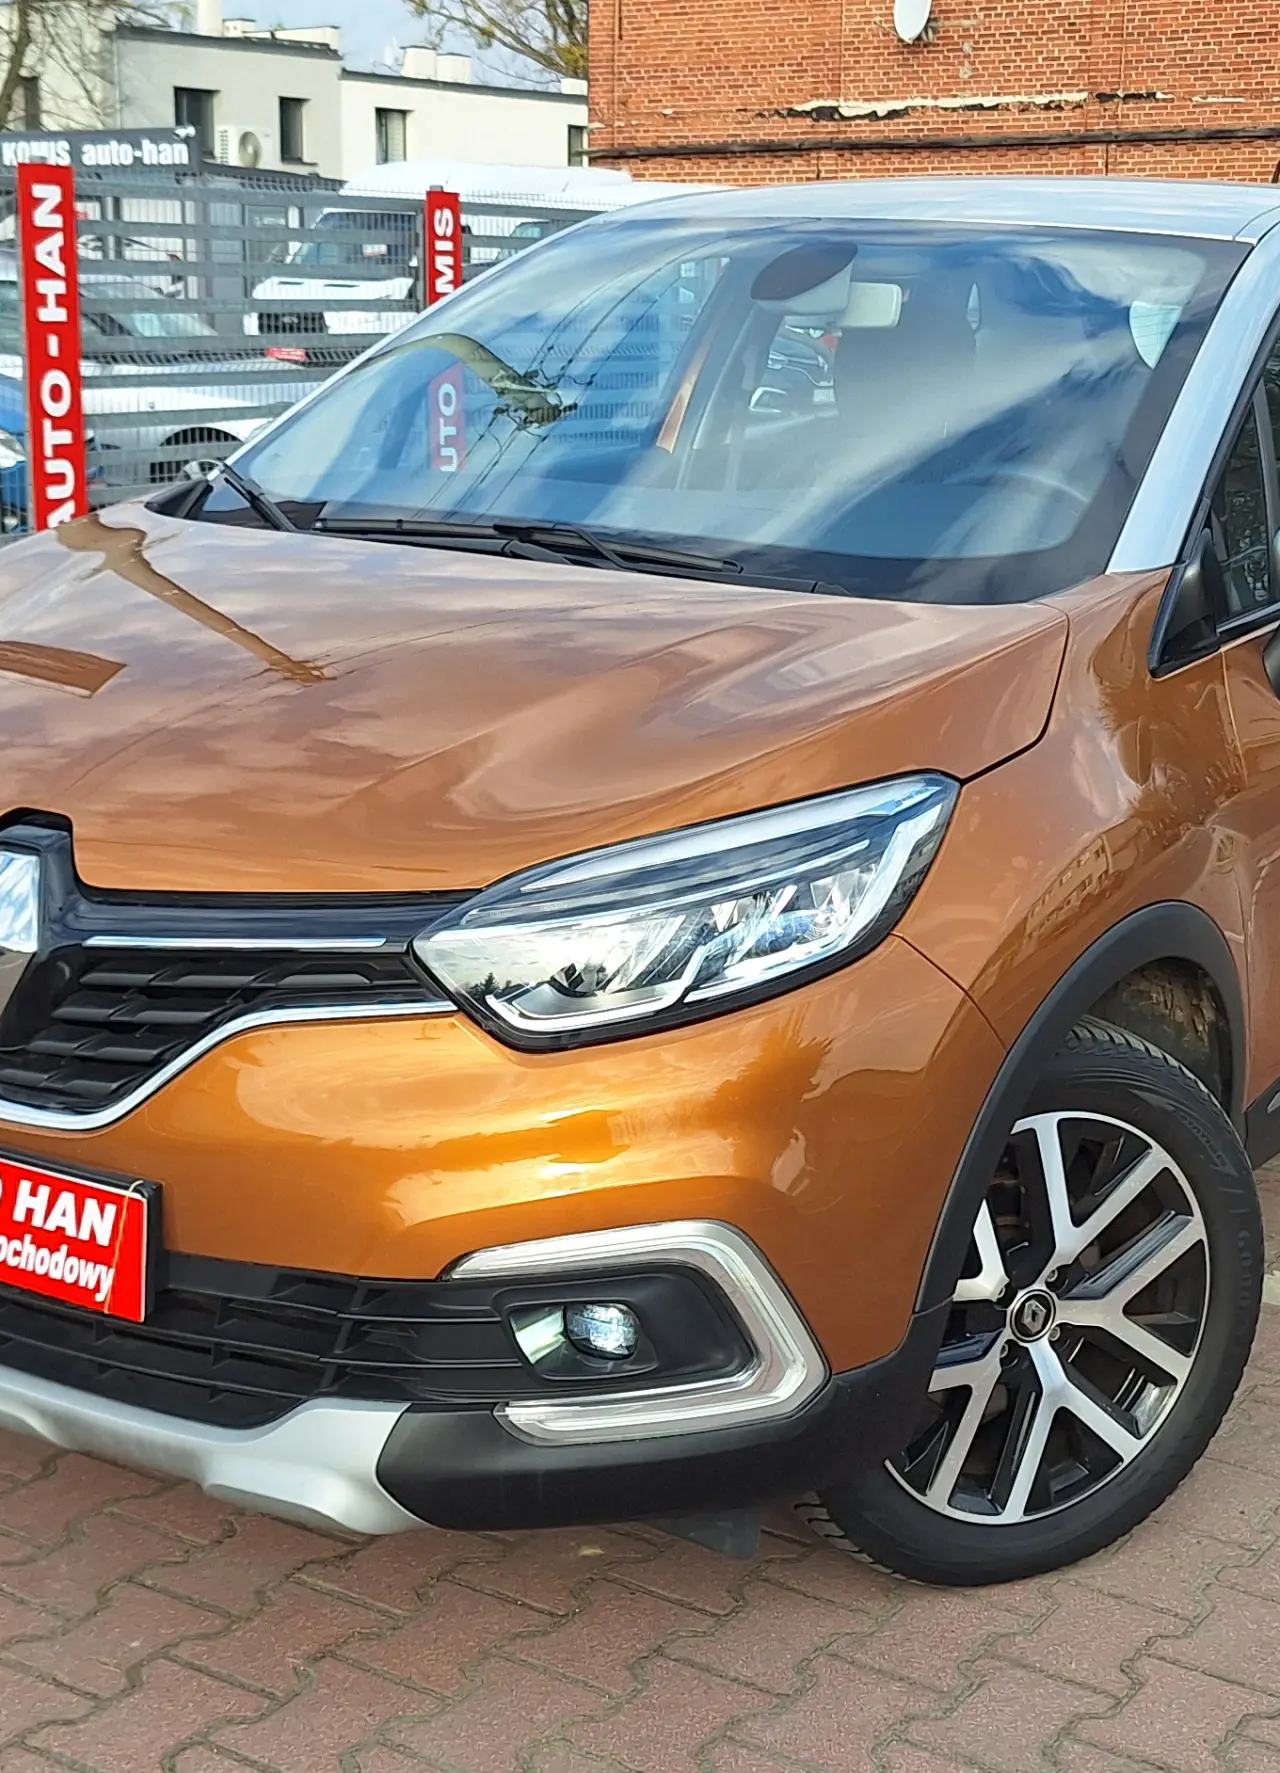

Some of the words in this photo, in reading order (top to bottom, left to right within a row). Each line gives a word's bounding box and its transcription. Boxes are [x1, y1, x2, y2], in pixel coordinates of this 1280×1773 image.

[81, 138, 190, 167] auto-han
[433, 208, 455, 294] MIS
[438, 383, 458, 472] UTO
[12, 1180, 118, 1247] HAN
